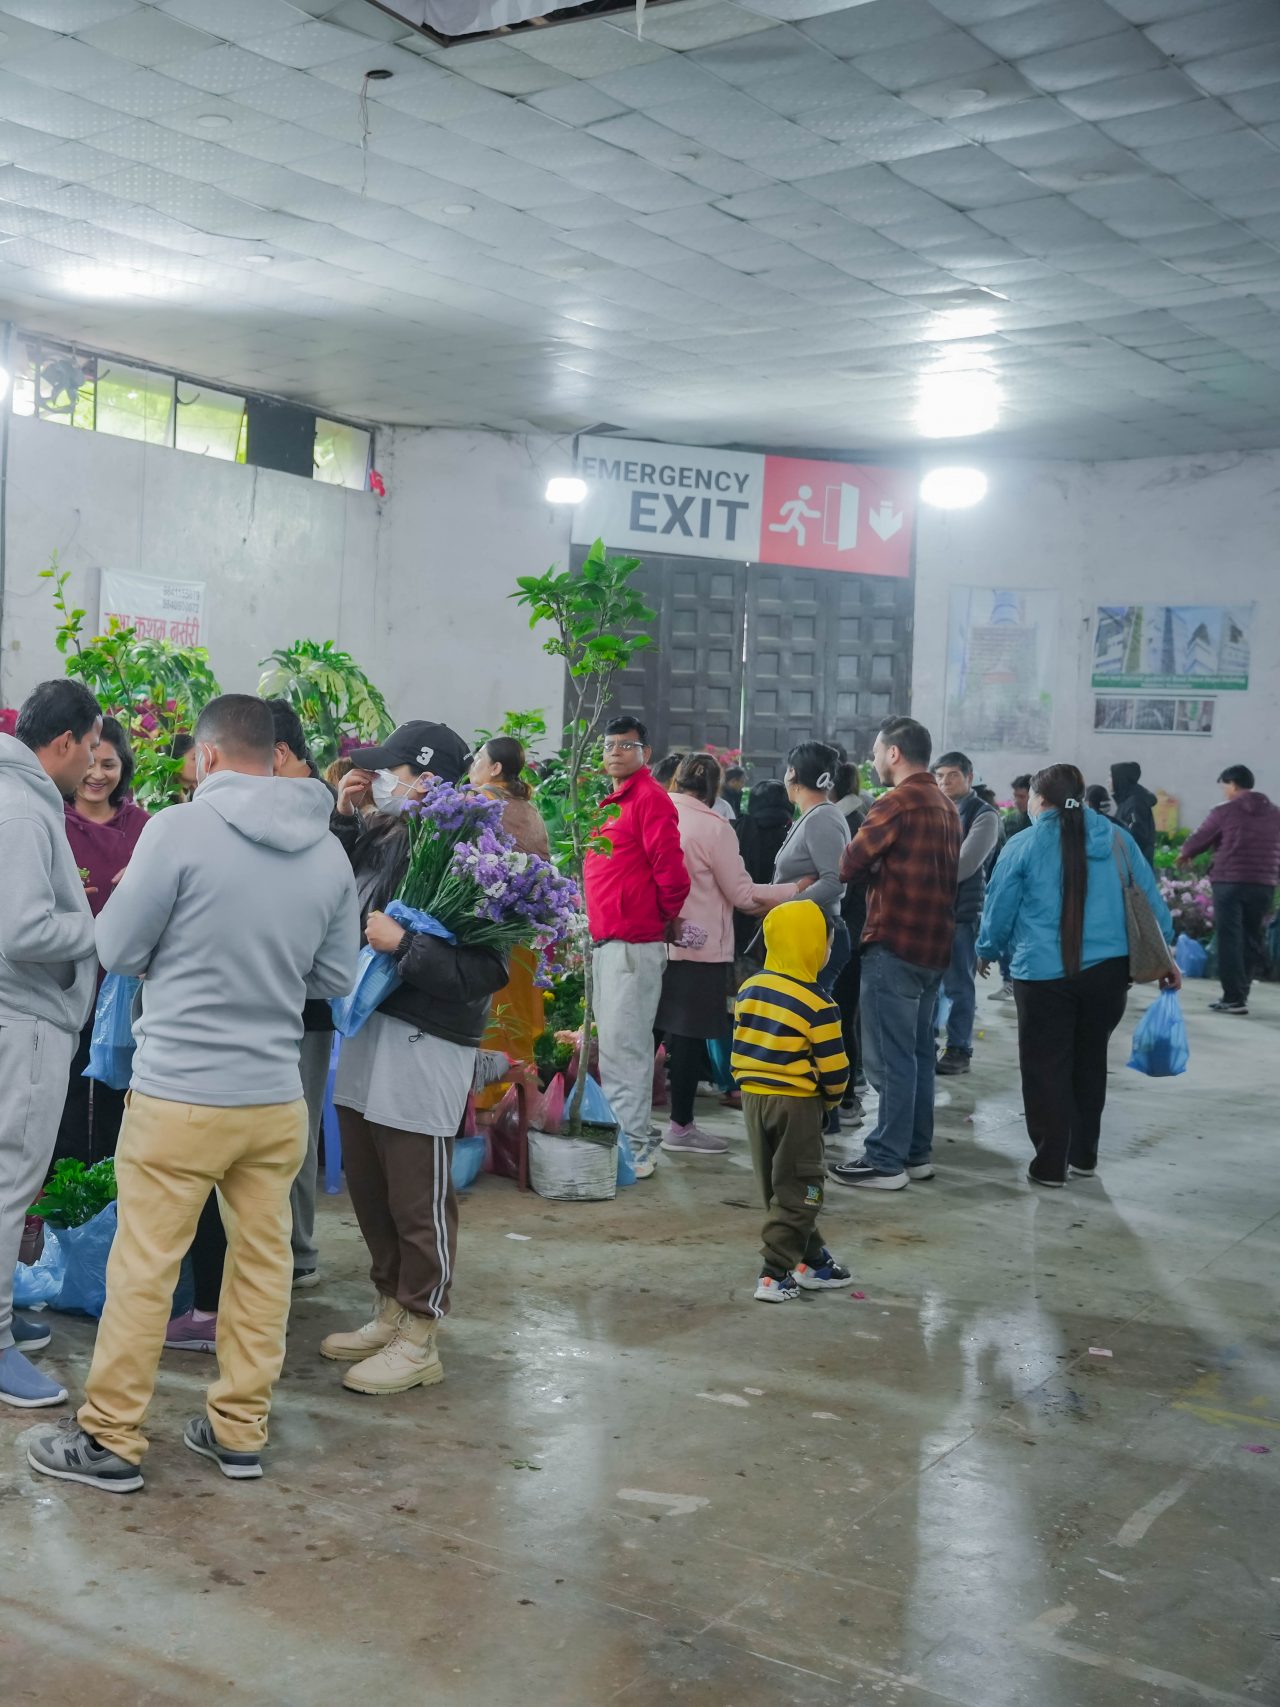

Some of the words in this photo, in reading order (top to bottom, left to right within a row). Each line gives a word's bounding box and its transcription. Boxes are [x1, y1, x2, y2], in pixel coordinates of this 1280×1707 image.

[581, 456, 750, 494] EMERGENCY
[629, 490, 750, 541] EXIT
[416, 746, 434, 766] 3
